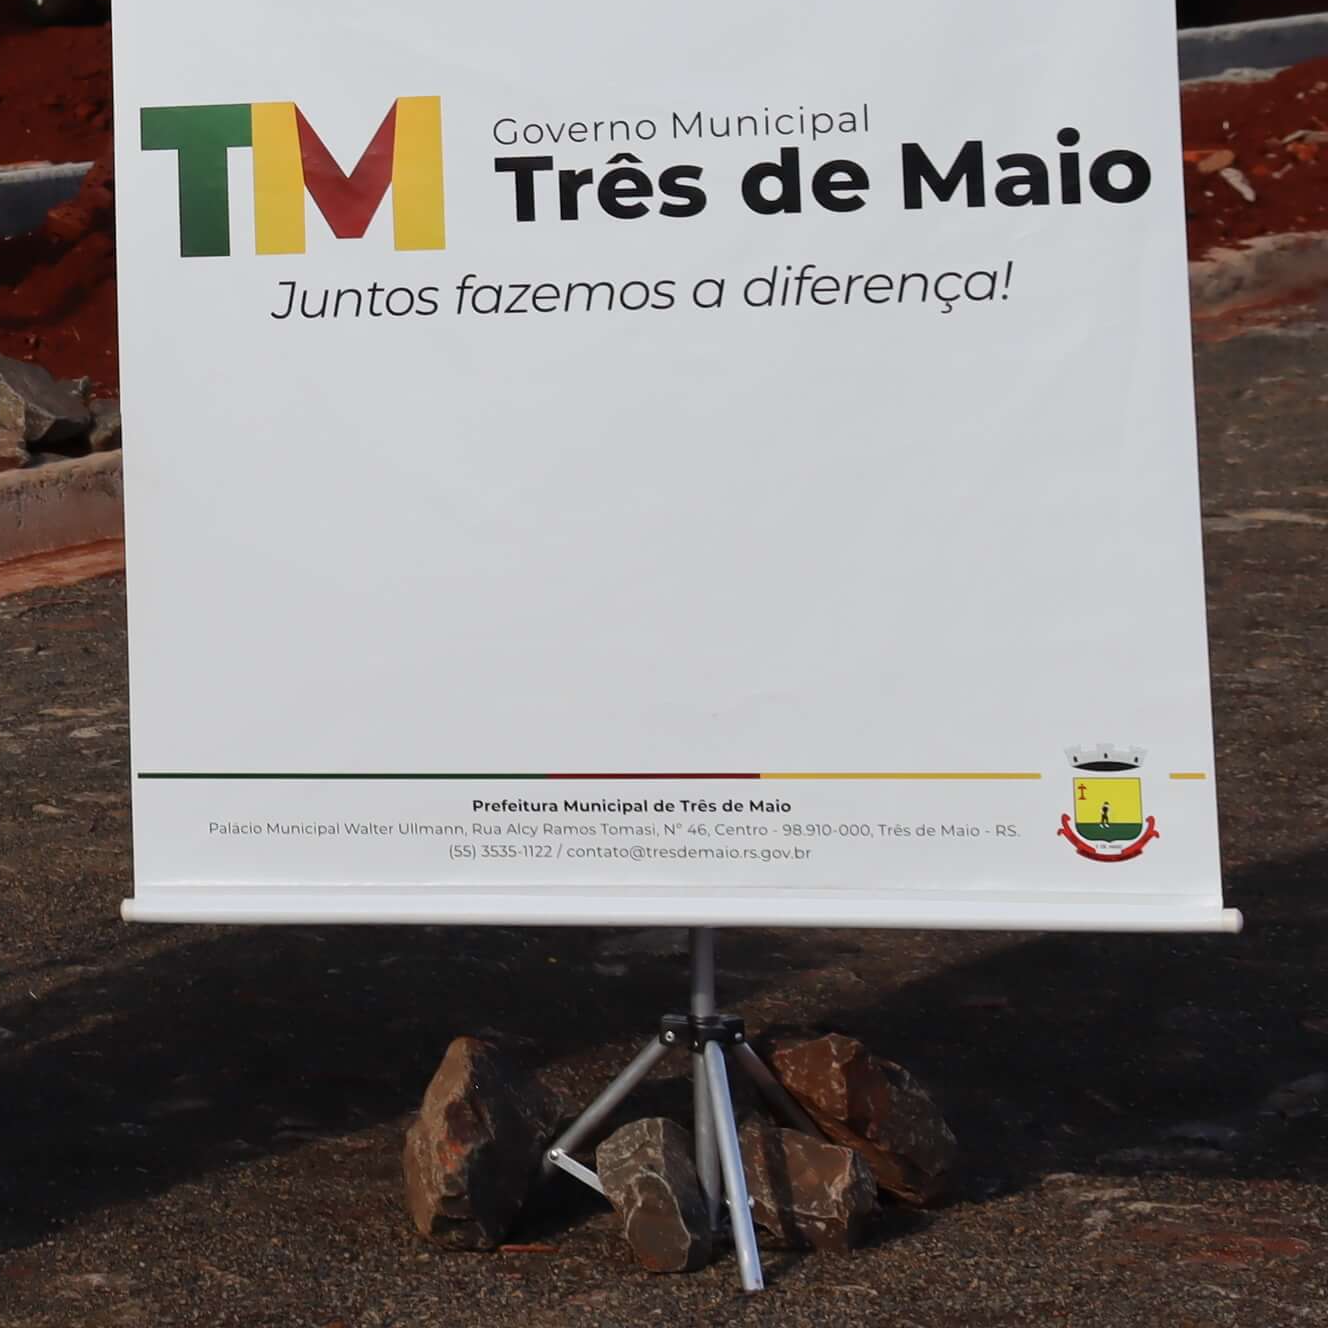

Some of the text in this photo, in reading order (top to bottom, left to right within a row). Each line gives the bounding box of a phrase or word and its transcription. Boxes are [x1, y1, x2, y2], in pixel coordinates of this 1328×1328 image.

[493, 103, 870, 145] Governo Municipal
[140, 95, 446, 258] TM
[494, 127, 1152, 222] Três de Maio
[271, 260, 1013, 320] Juntos fazemos a diferença!
[473, 798, 791, 816] Prefeitura Municipal de Três de Maio
[209, 820, 262, 836] Palácio
[266, 821, 340, 839] Municipal
[343, 821, 393, 836] Walter
[398, 821, 468, 838] Ullmann,
[473, 822, 502, 837] Rua
[507, 822, 539, 840] Alcy
[543, 822, 597, 837] Ramos
[601, 822, 659, 839] Tomasi,
[688, 823, 710, 839] 46,
[715, 822, 768, 837] Centro
[782, 823, 873, 839] 98.910-000,
[878, 822, 911, 837] Três
[915, 822, 936, 837] de
[941, 822, 980, 837] Maio
[995, 824, 1020, 838] RS.
[448, 843, 812, 862] (55) 3535-1122 / contato@tresdemaio.rs.gov.br
